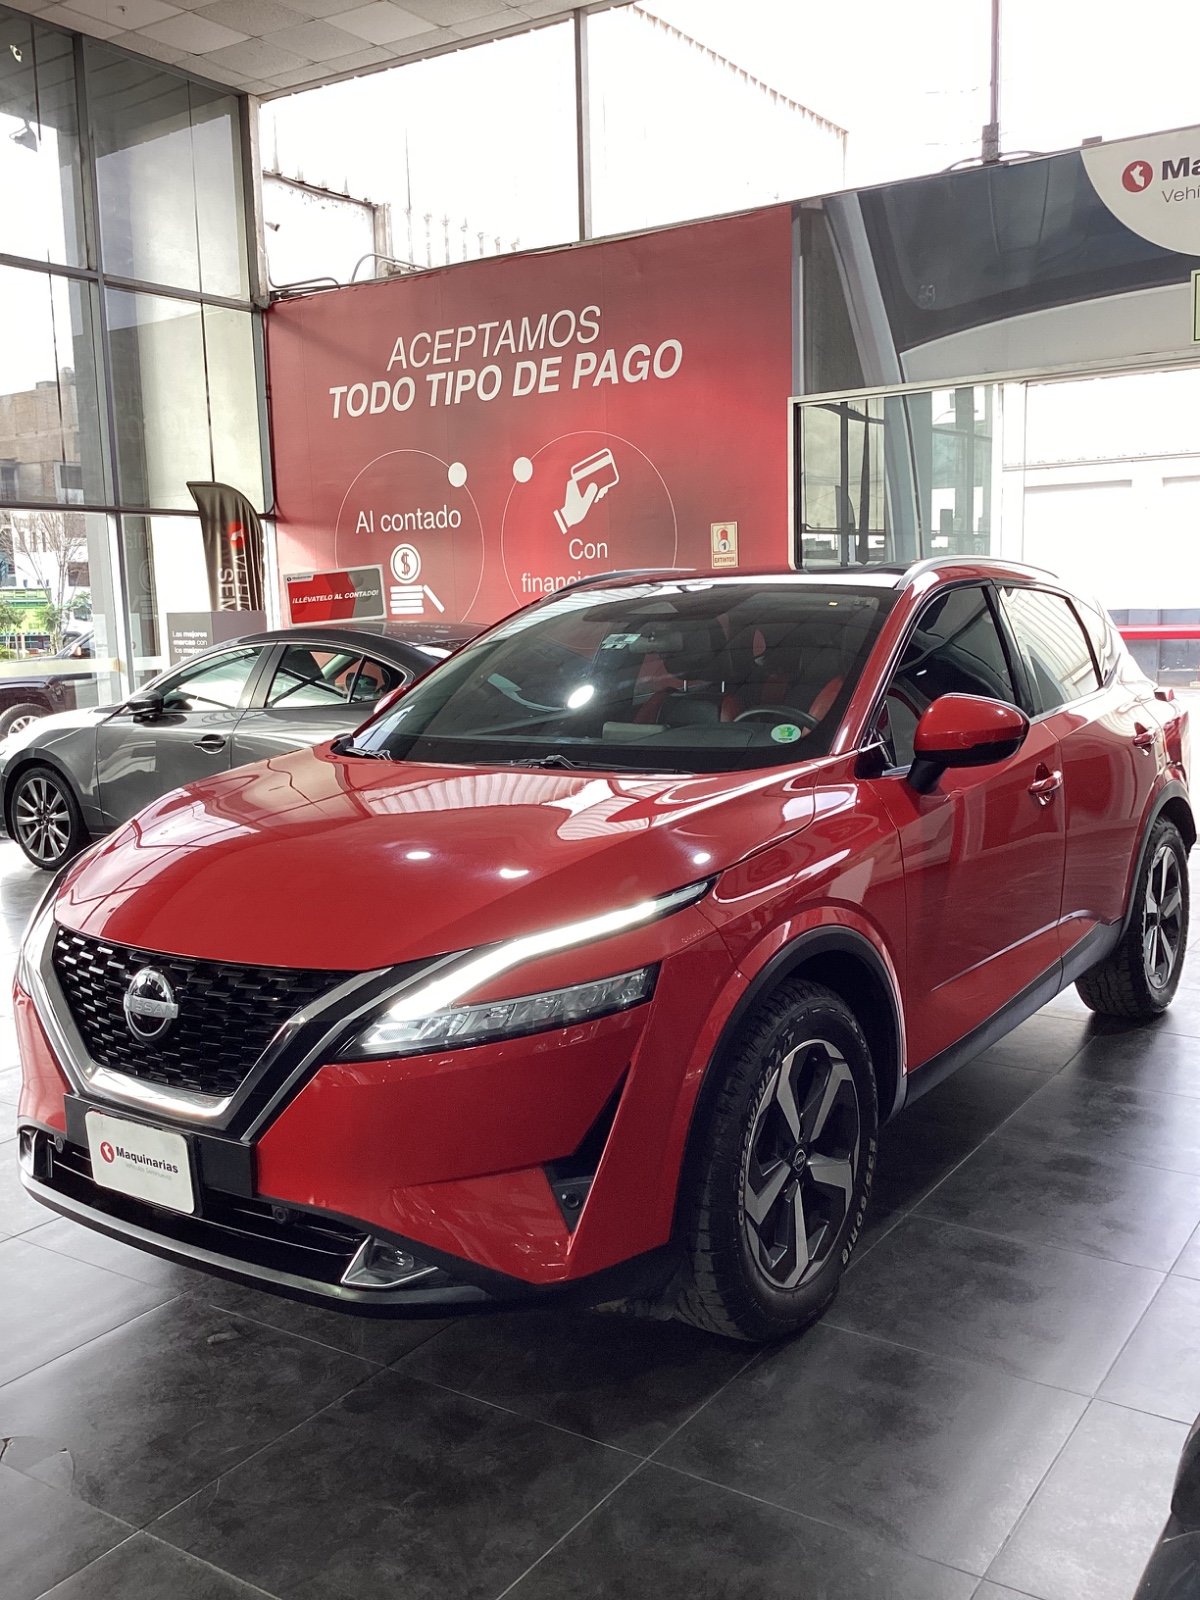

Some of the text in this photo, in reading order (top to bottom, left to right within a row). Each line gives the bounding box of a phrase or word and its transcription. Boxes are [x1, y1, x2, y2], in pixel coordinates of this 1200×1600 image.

[387, 305, 602, 371] ACEPTAMOS
[329, 339, 684, 419] TODO TIPO DE PAGO
[355, 504, 462, 534] Al contado
[569, 538, 609, 560] Con
[344, 590, 379, 599] CONTADO!
[183, 630, 208, 638] mejores
[115, 1146, 179, 1174] Maquinarias
